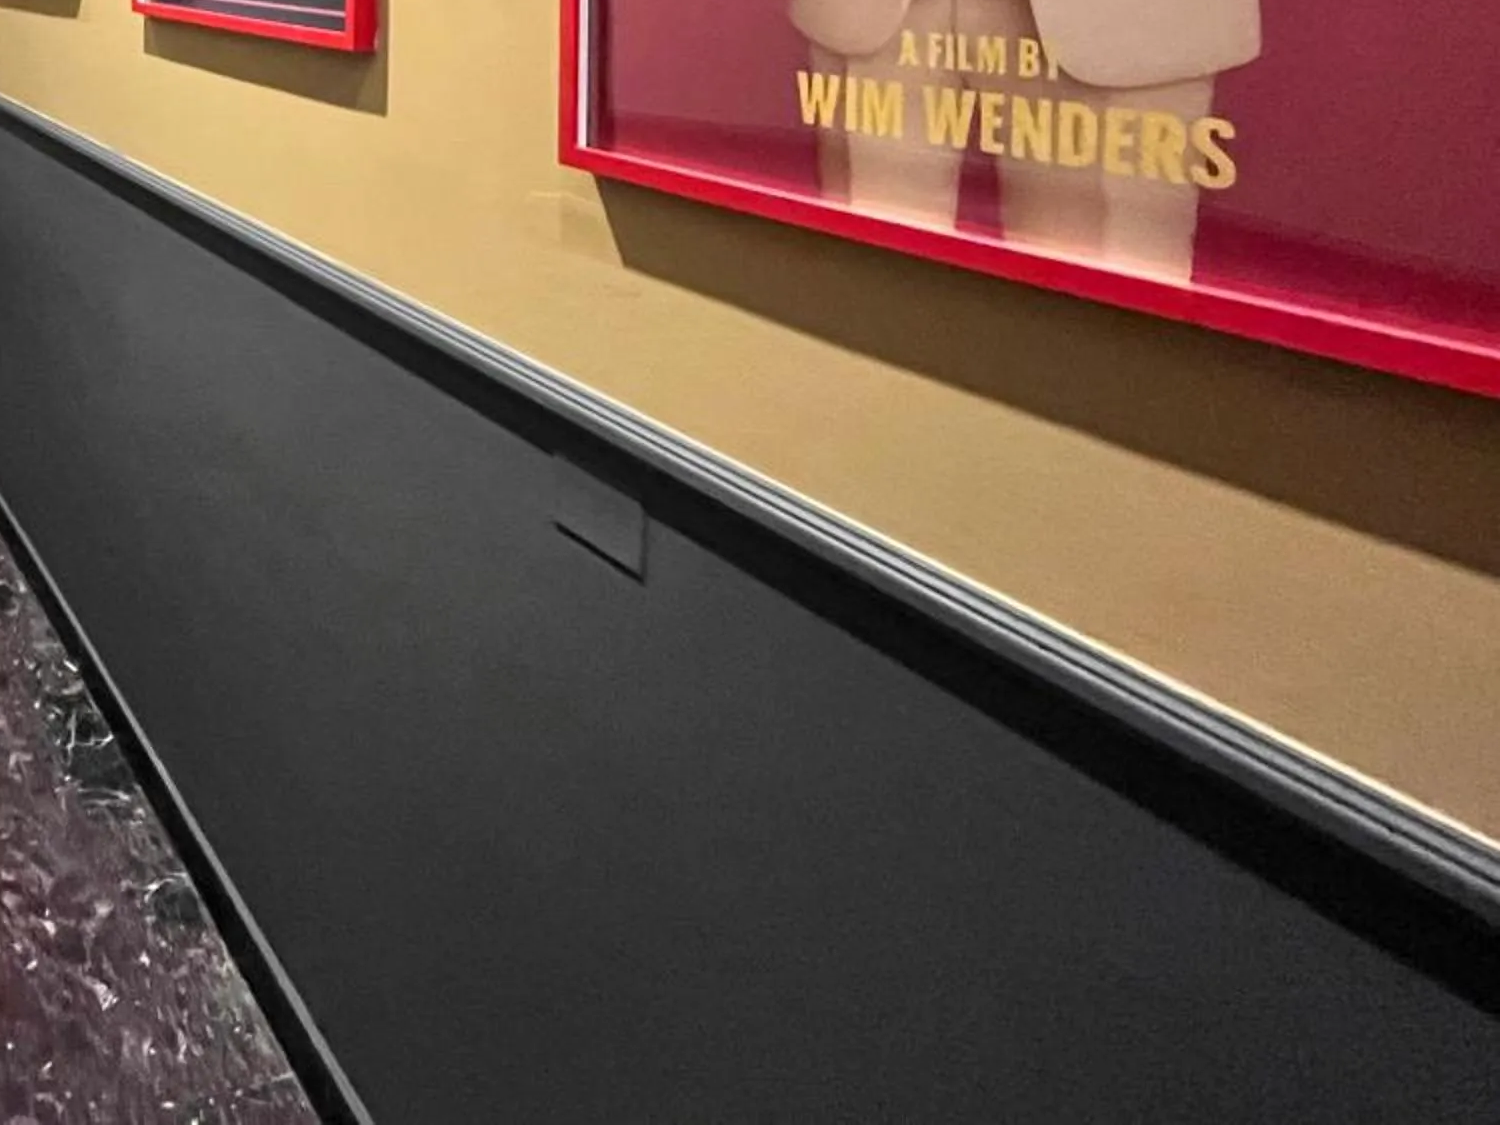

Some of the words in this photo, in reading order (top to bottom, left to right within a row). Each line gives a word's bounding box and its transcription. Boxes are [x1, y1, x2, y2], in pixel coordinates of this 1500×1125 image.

[897, 29, 920, 68] A
[928, 32, 1007, 76] FILM
[797, 70, 904, 140] WIM
[923, 85, 1238, 191] WENDERS
